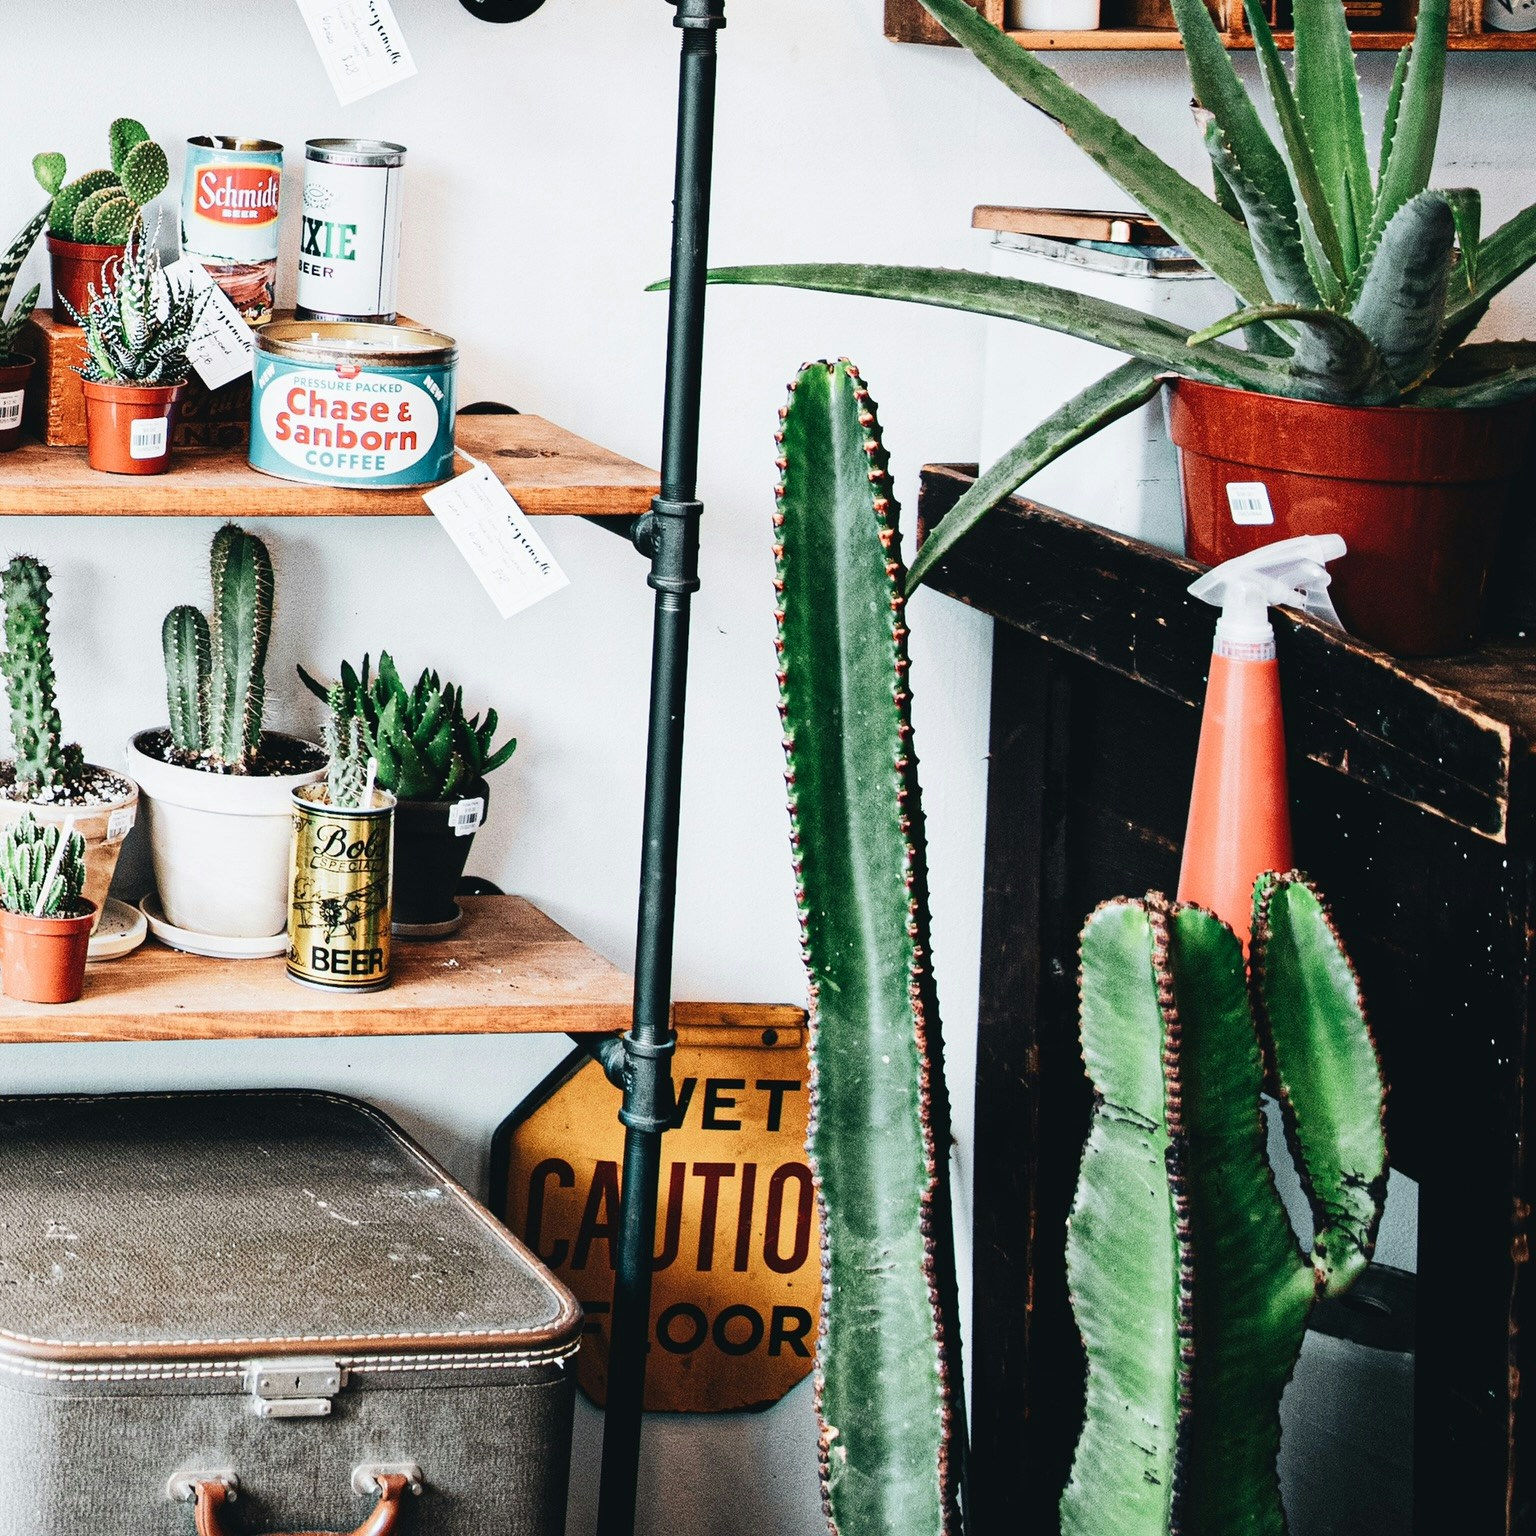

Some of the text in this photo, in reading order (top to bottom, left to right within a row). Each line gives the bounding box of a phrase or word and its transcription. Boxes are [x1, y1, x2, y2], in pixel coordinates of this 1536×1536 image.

[198, 171, 278, 210] Schmidt
[222, 209, 259, 218] BEER
[300, 215, 357, 261] IXIE
[298, 259, 334, 278] BEER
[258, 363, 276, 390] NEW
[293, 376, 403, 394] PRESSURE PACKED
[423, 374, 445, 402] NEW
[286, 387, 412, 423] Chase &
[275, 411, 418, 452] Sanborn
[305, 450, 386, 471] COFFEE
[311, 946, 383, 976] BEER
[525, 1157, 818, 1275] CAUTIO
[582, 1300, 814, 1358] FOOR
